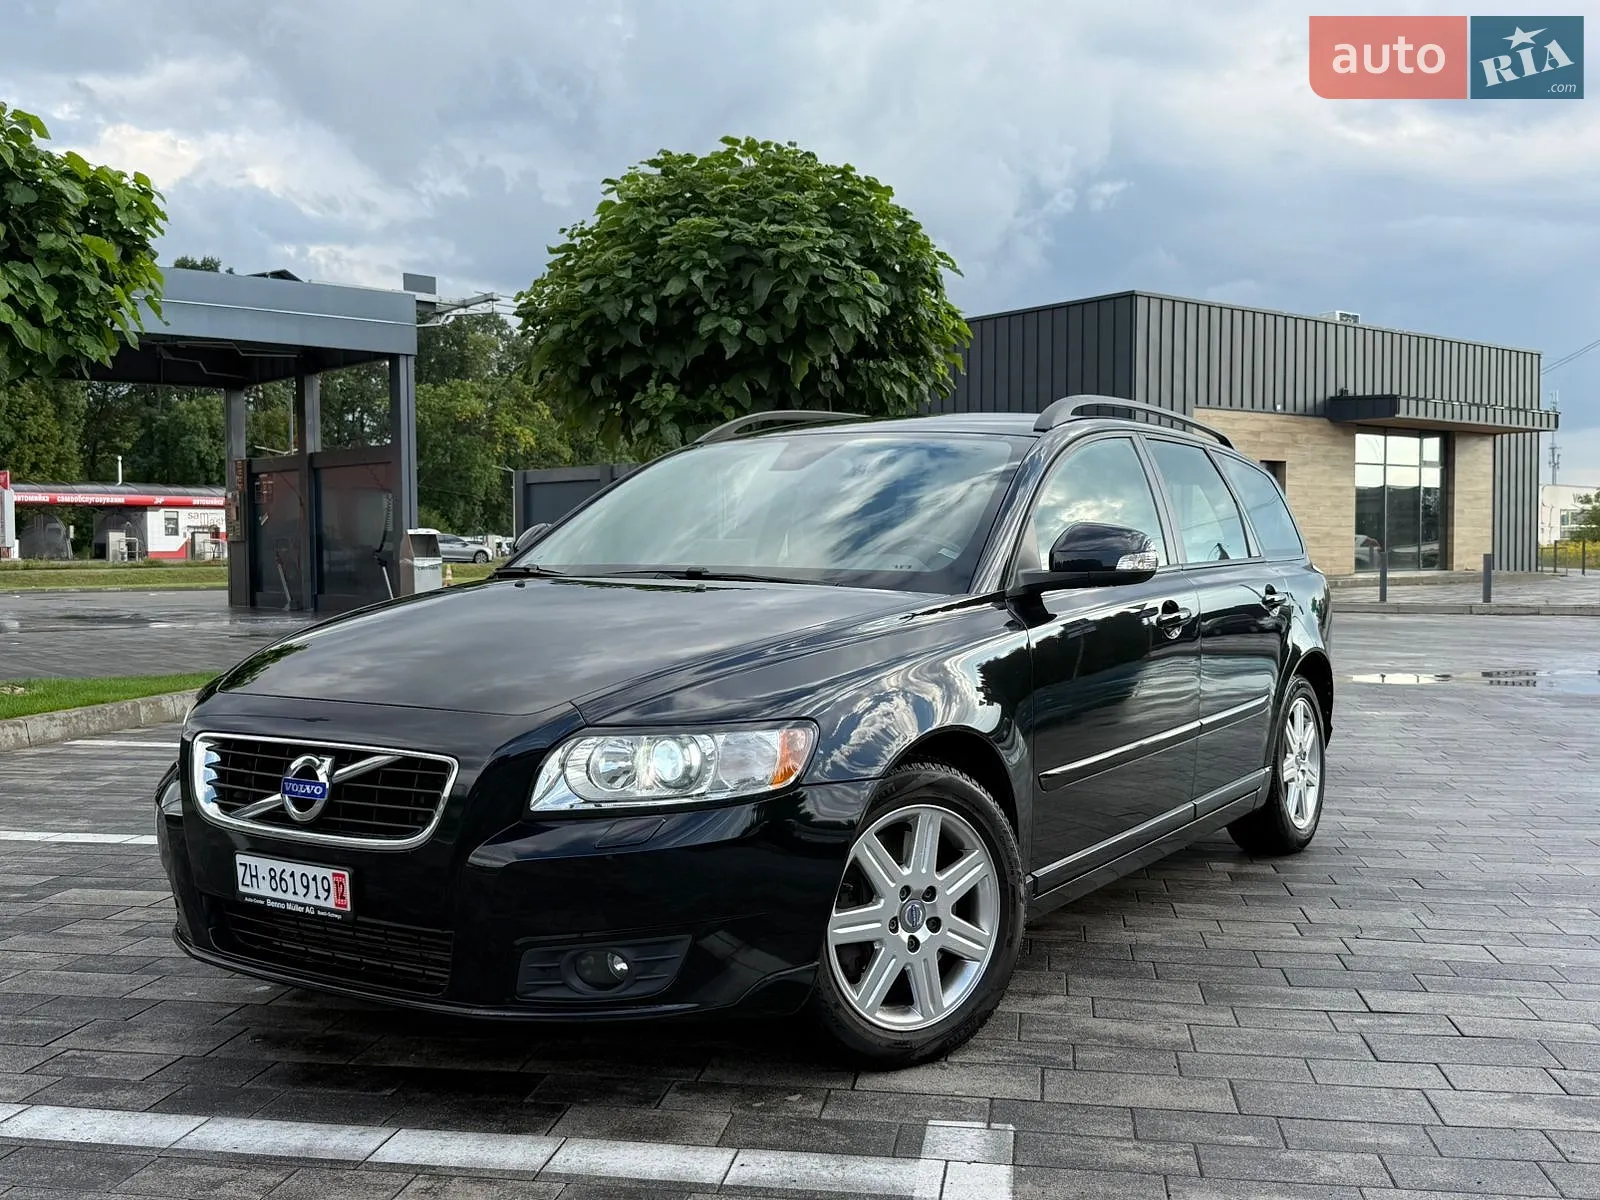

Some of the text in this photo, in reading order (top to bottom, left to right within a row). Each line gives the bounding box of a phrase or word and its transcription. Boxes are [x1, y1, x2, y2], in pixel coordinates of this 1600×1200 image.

[284, 782, 323, 795] VOLVO
[266, 898, 315, 915] Benno Müller AG
